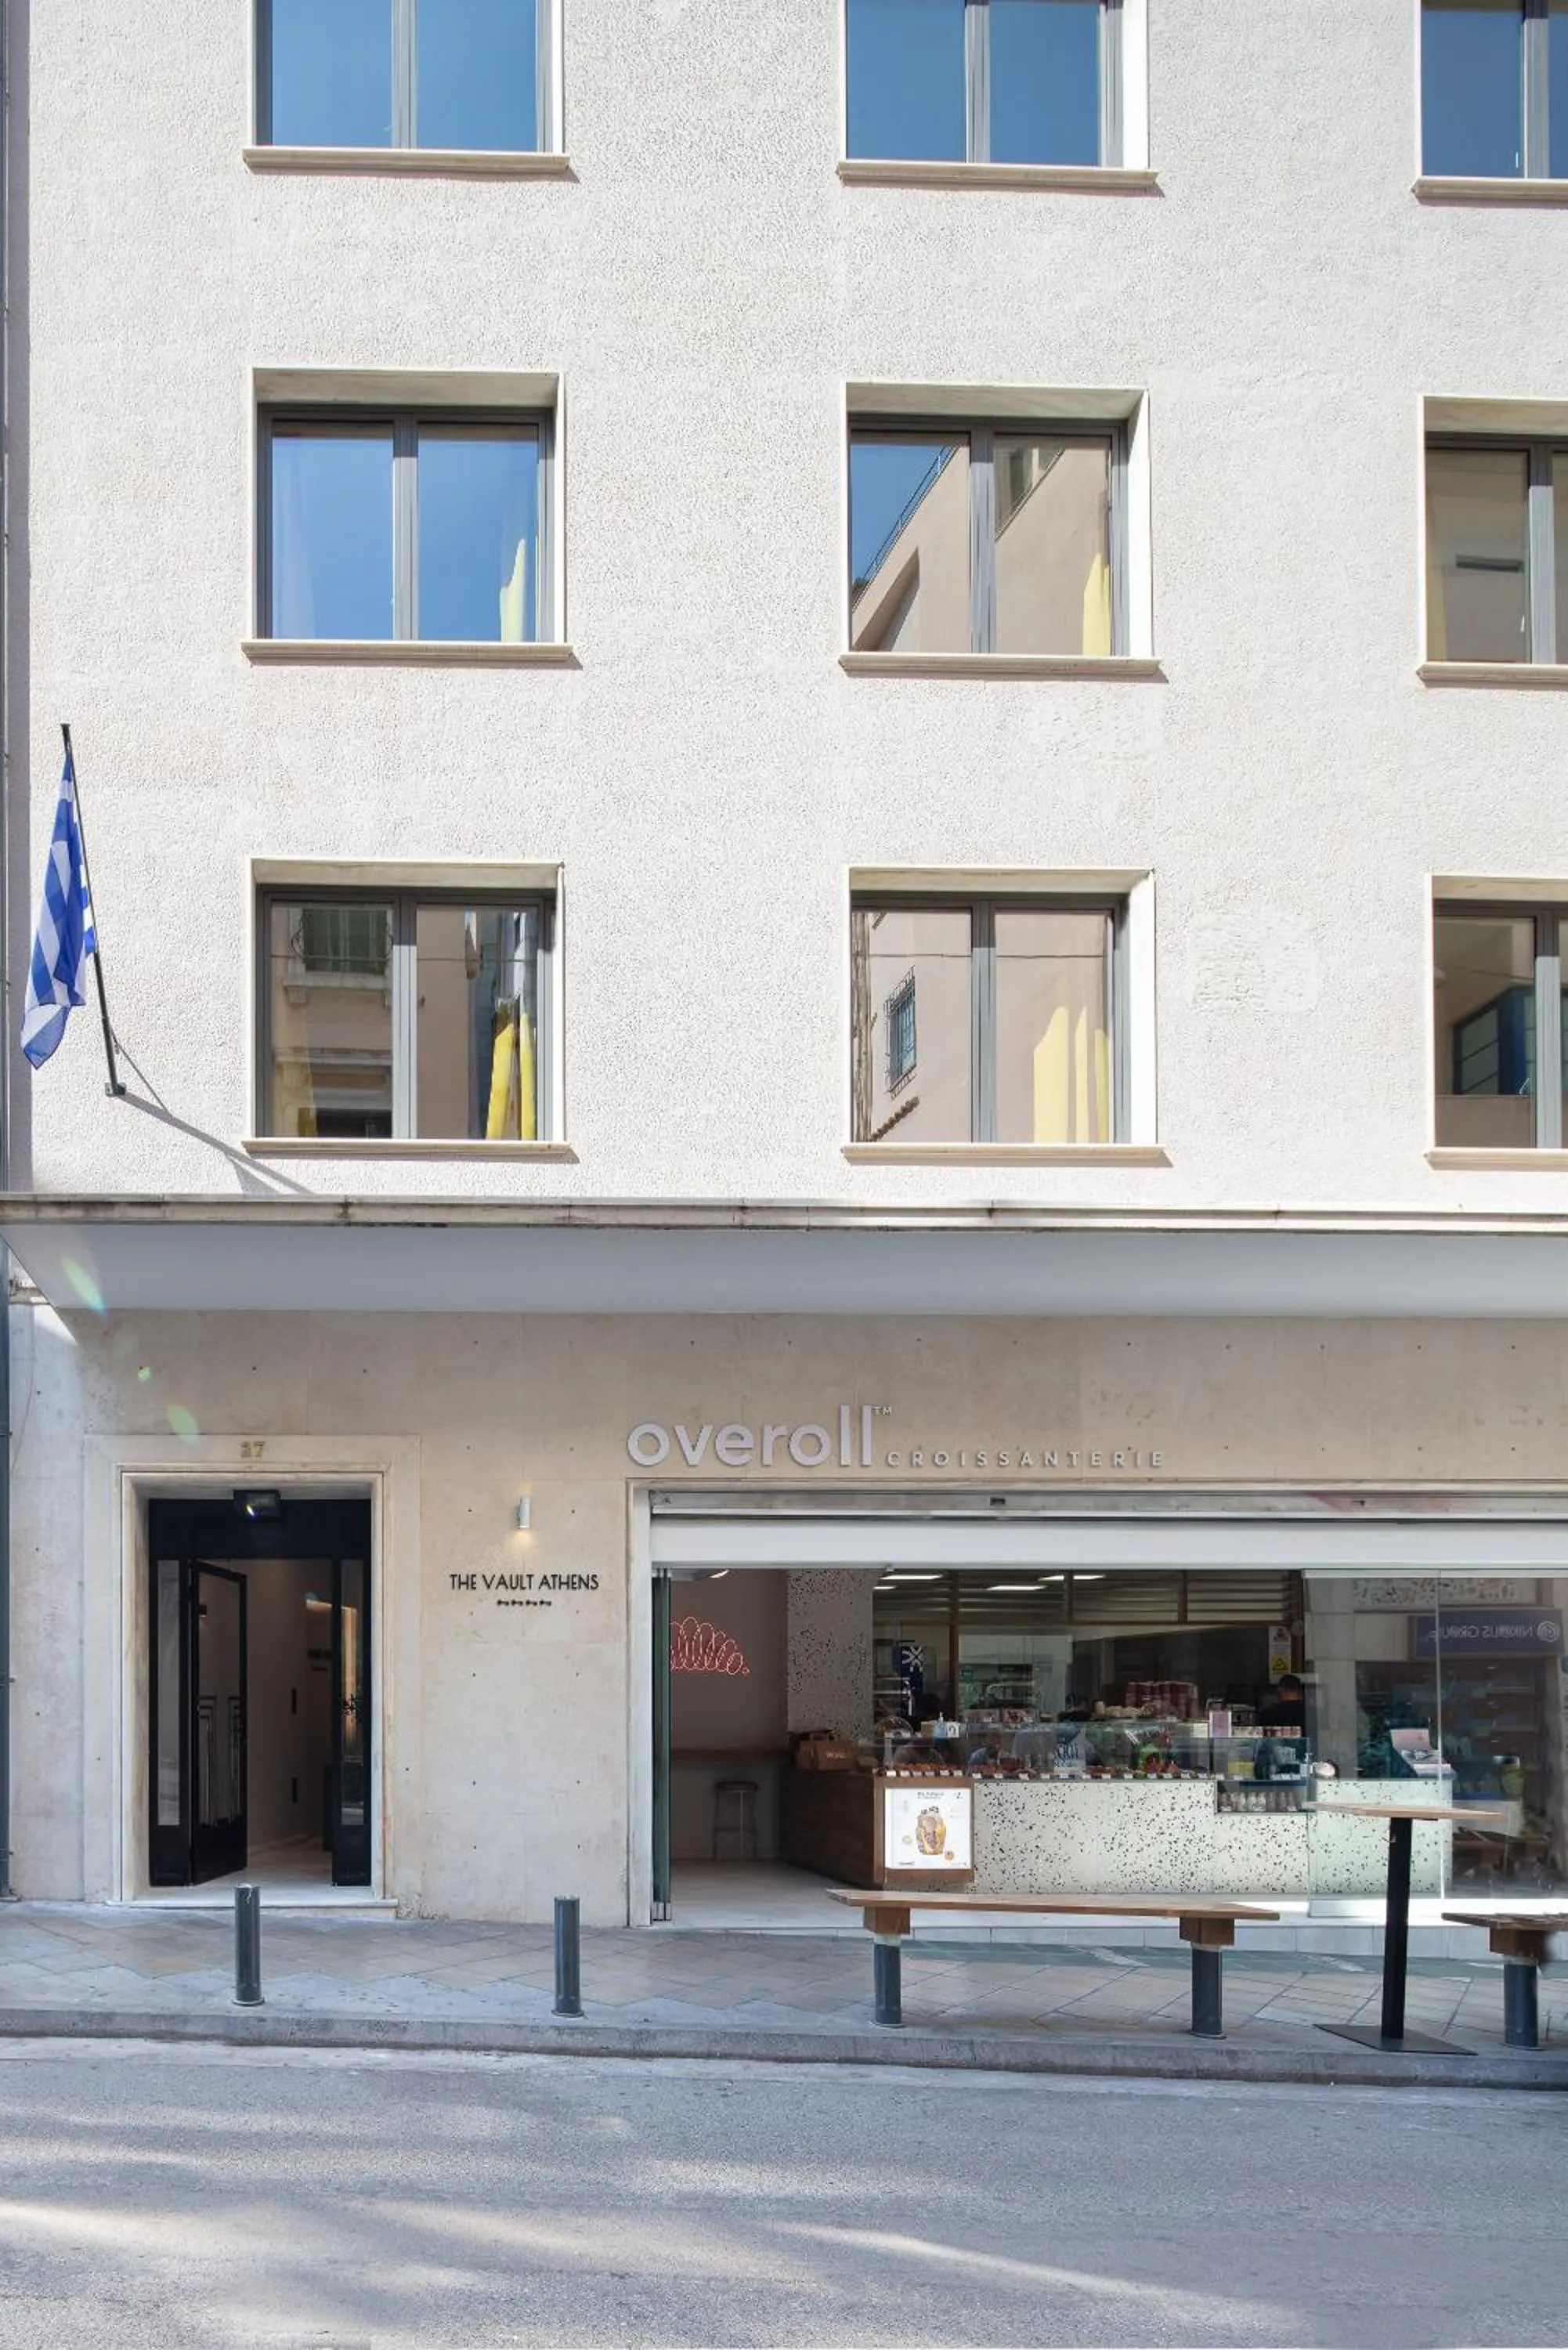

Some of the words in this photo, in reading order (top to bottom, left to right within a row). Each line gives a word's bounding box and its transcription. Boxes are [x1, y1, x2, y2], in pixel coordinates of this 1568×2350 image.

[627, 1405, 873, 1467] overoll
[887, 1451, 1165, 1469] CROISSANTERIE
[450, 1574, 477, 1590] THE
[482, 1574, 533, 1590] VAULT
[538, 1574, 599, 1590] ATHENS
